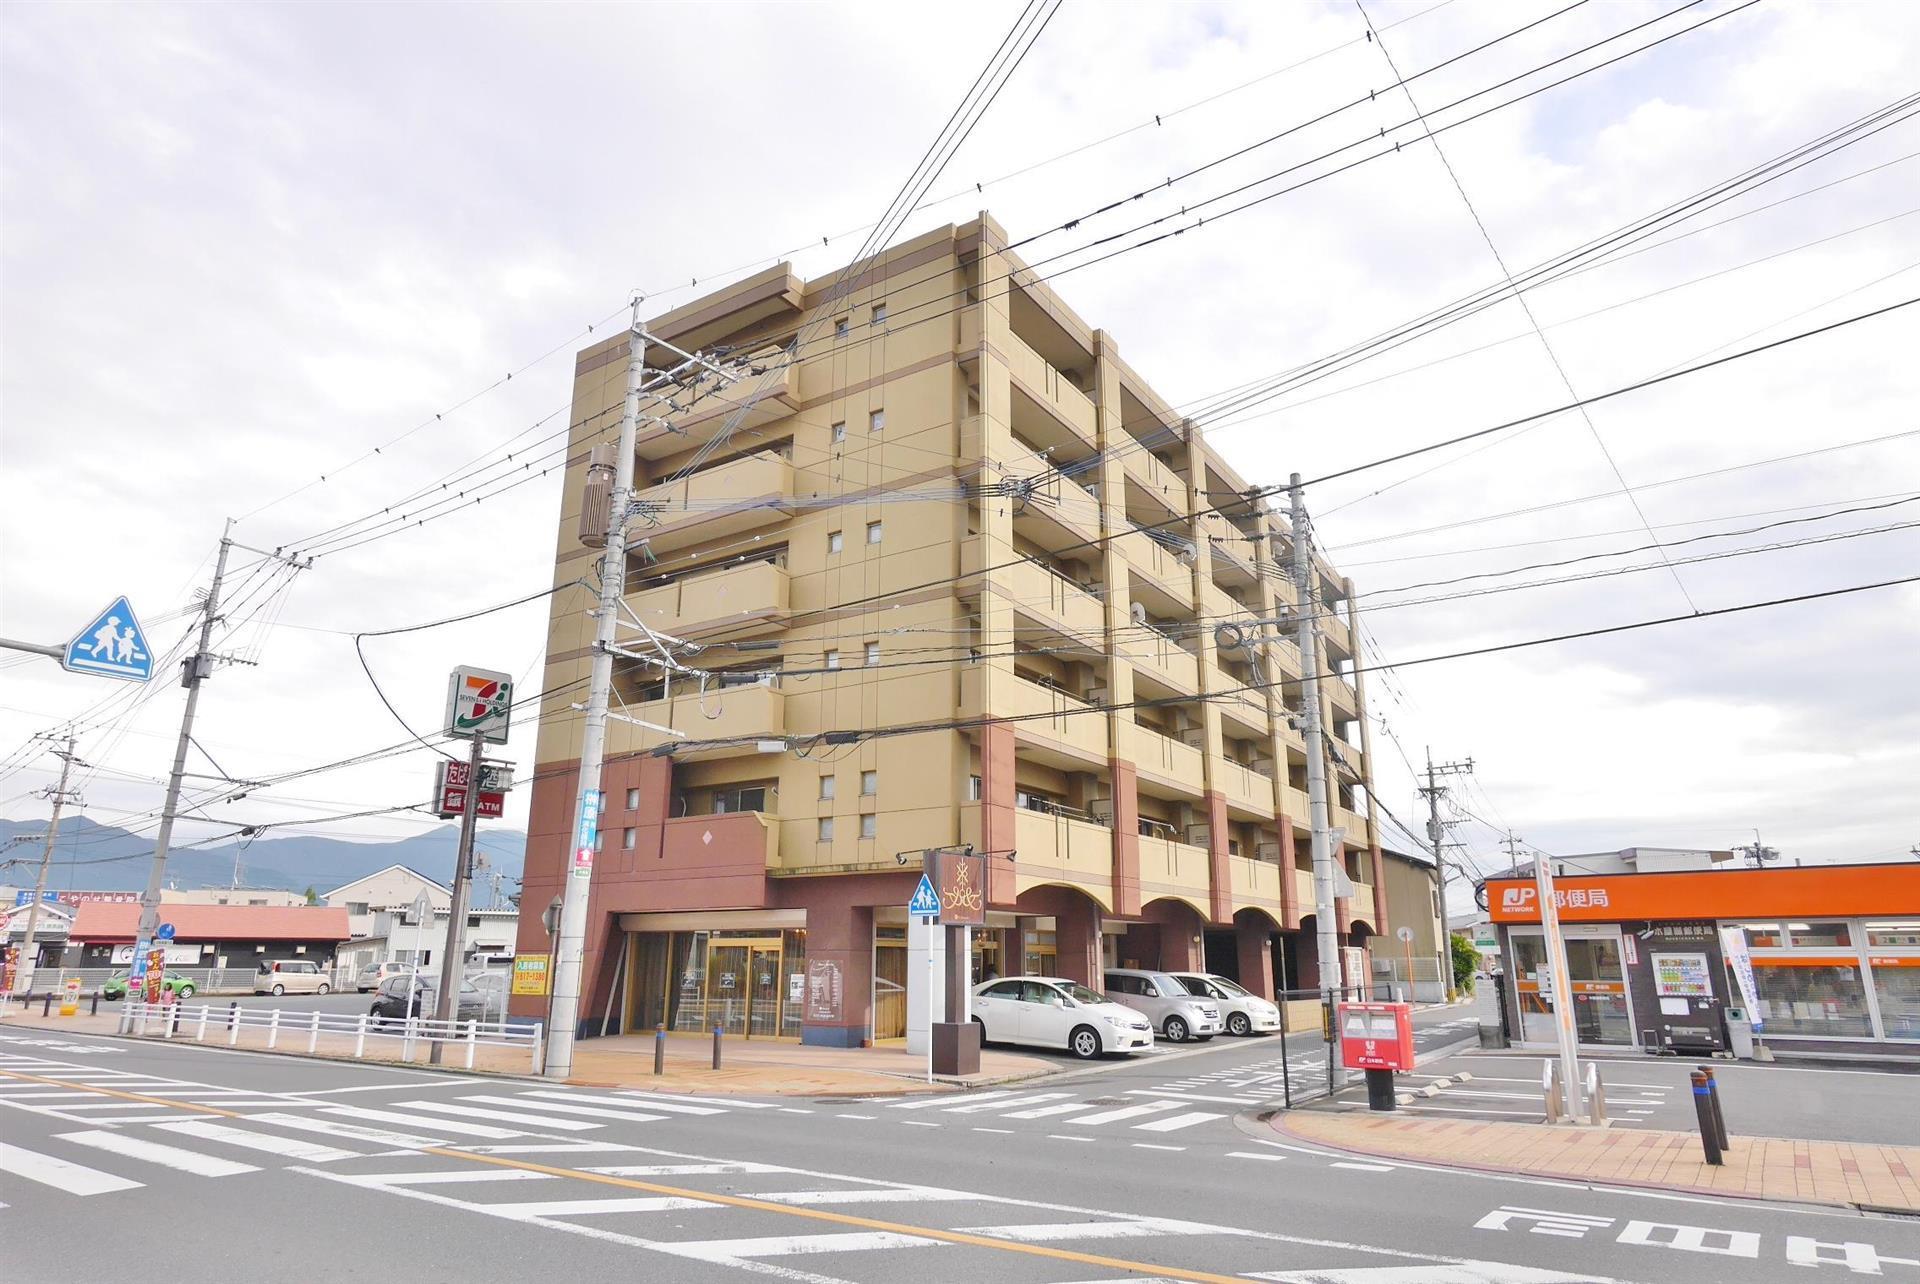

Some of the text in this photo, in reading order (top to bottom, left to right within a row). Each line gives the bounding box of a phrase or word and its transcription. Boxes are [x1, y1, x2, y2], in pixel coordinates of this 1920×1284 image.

[447, 763, 471, 785] たば
[477, 801, 500, 812] ATM
[1502, 887, 1536, 906] JP
